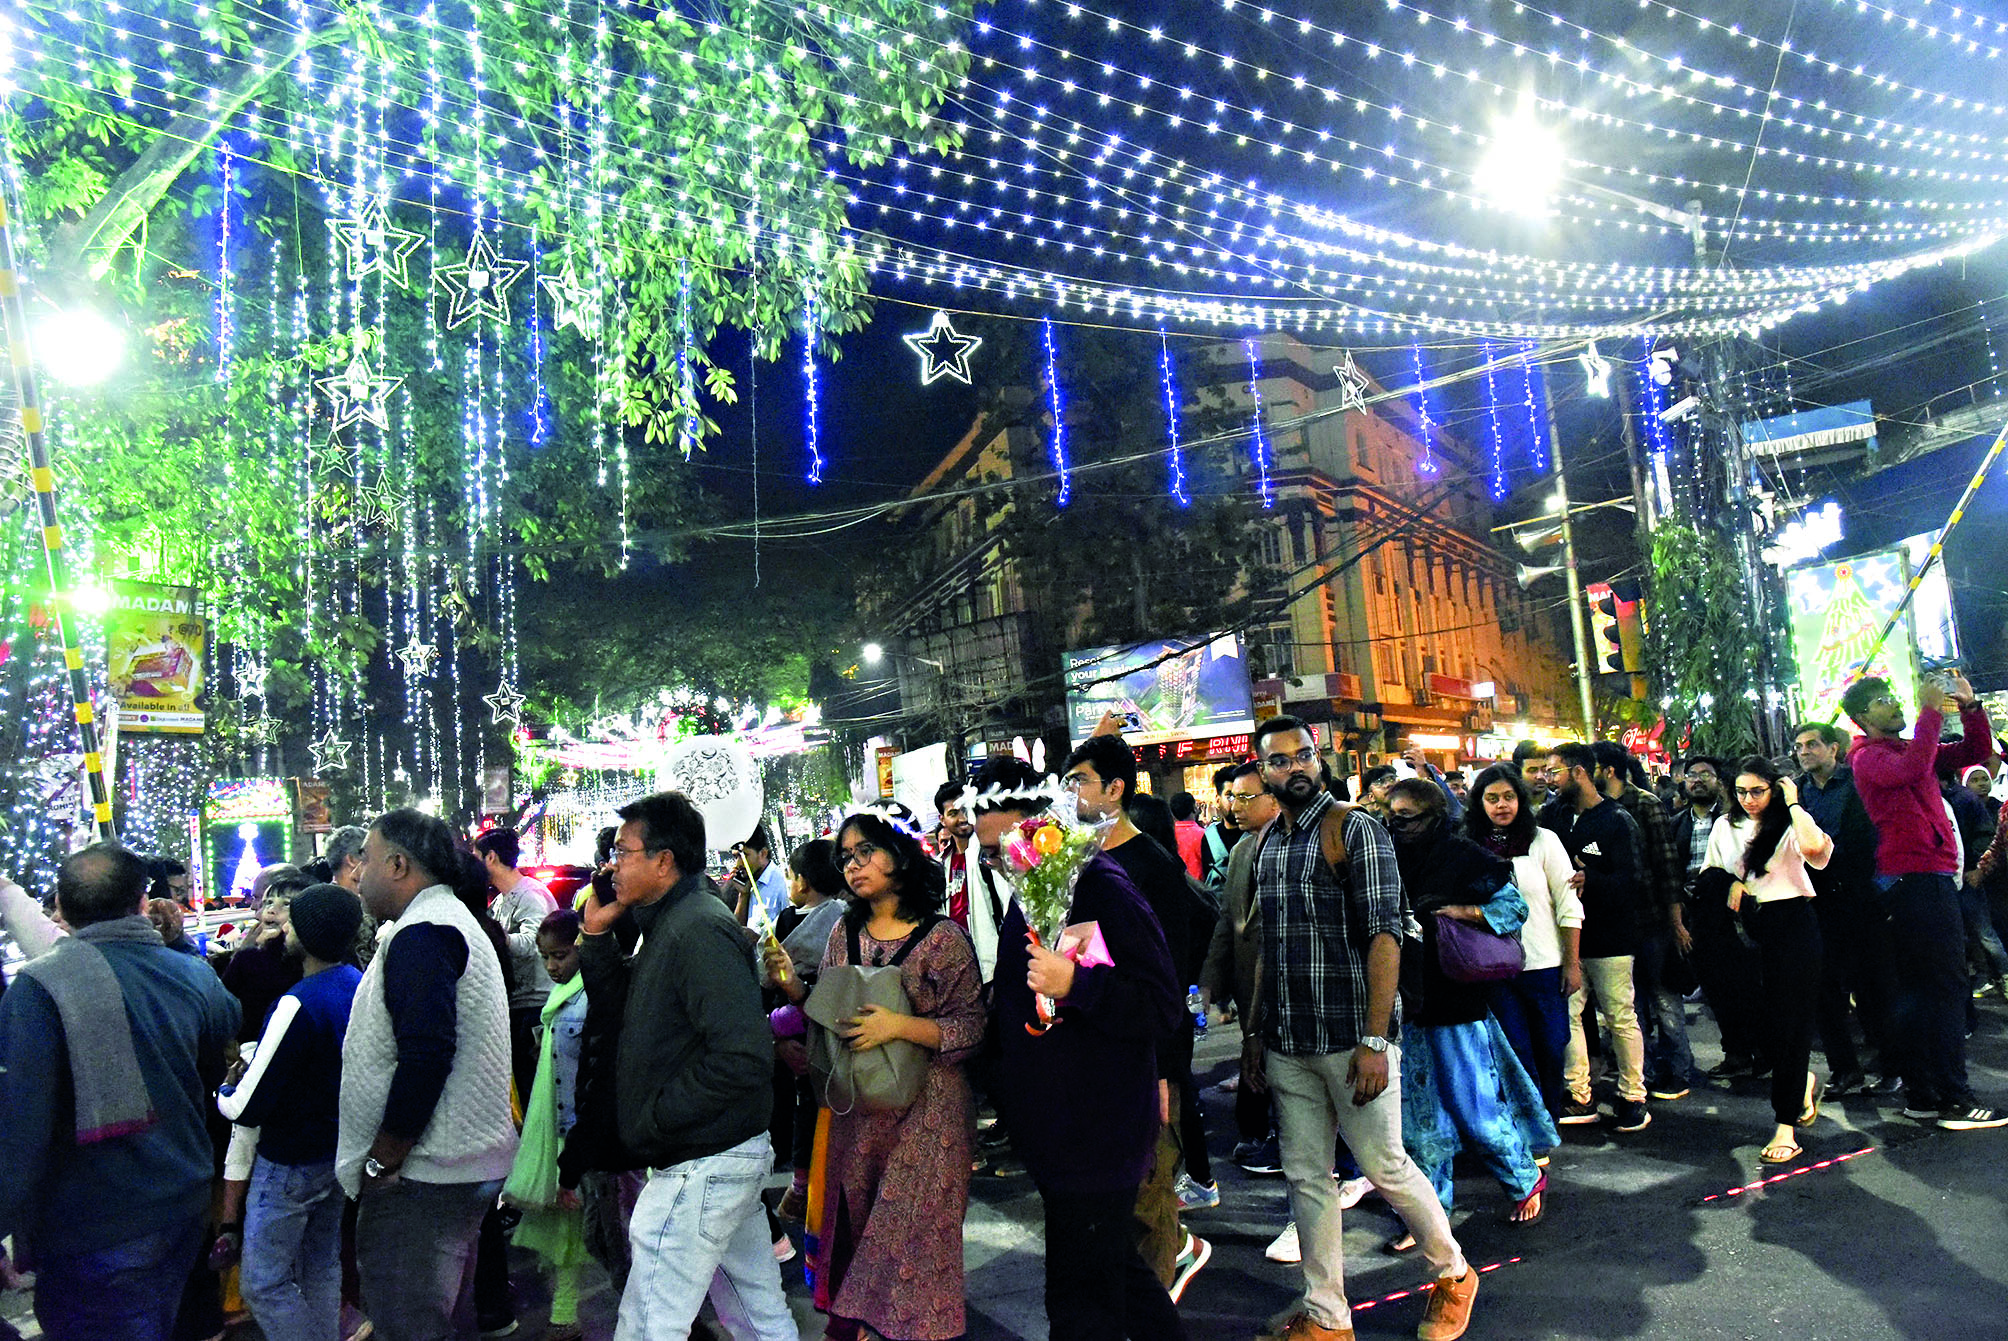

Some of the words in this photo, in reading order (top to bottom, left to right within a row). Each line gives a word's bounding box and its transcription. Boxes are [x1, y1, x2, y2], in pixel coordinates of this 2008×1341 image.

[112, 596, 204, 616] MADAME
[1071, 670, 1097, 683] your
[119, 701, 165, 710] Available
[1582, 848, 1602, 856] adidas
